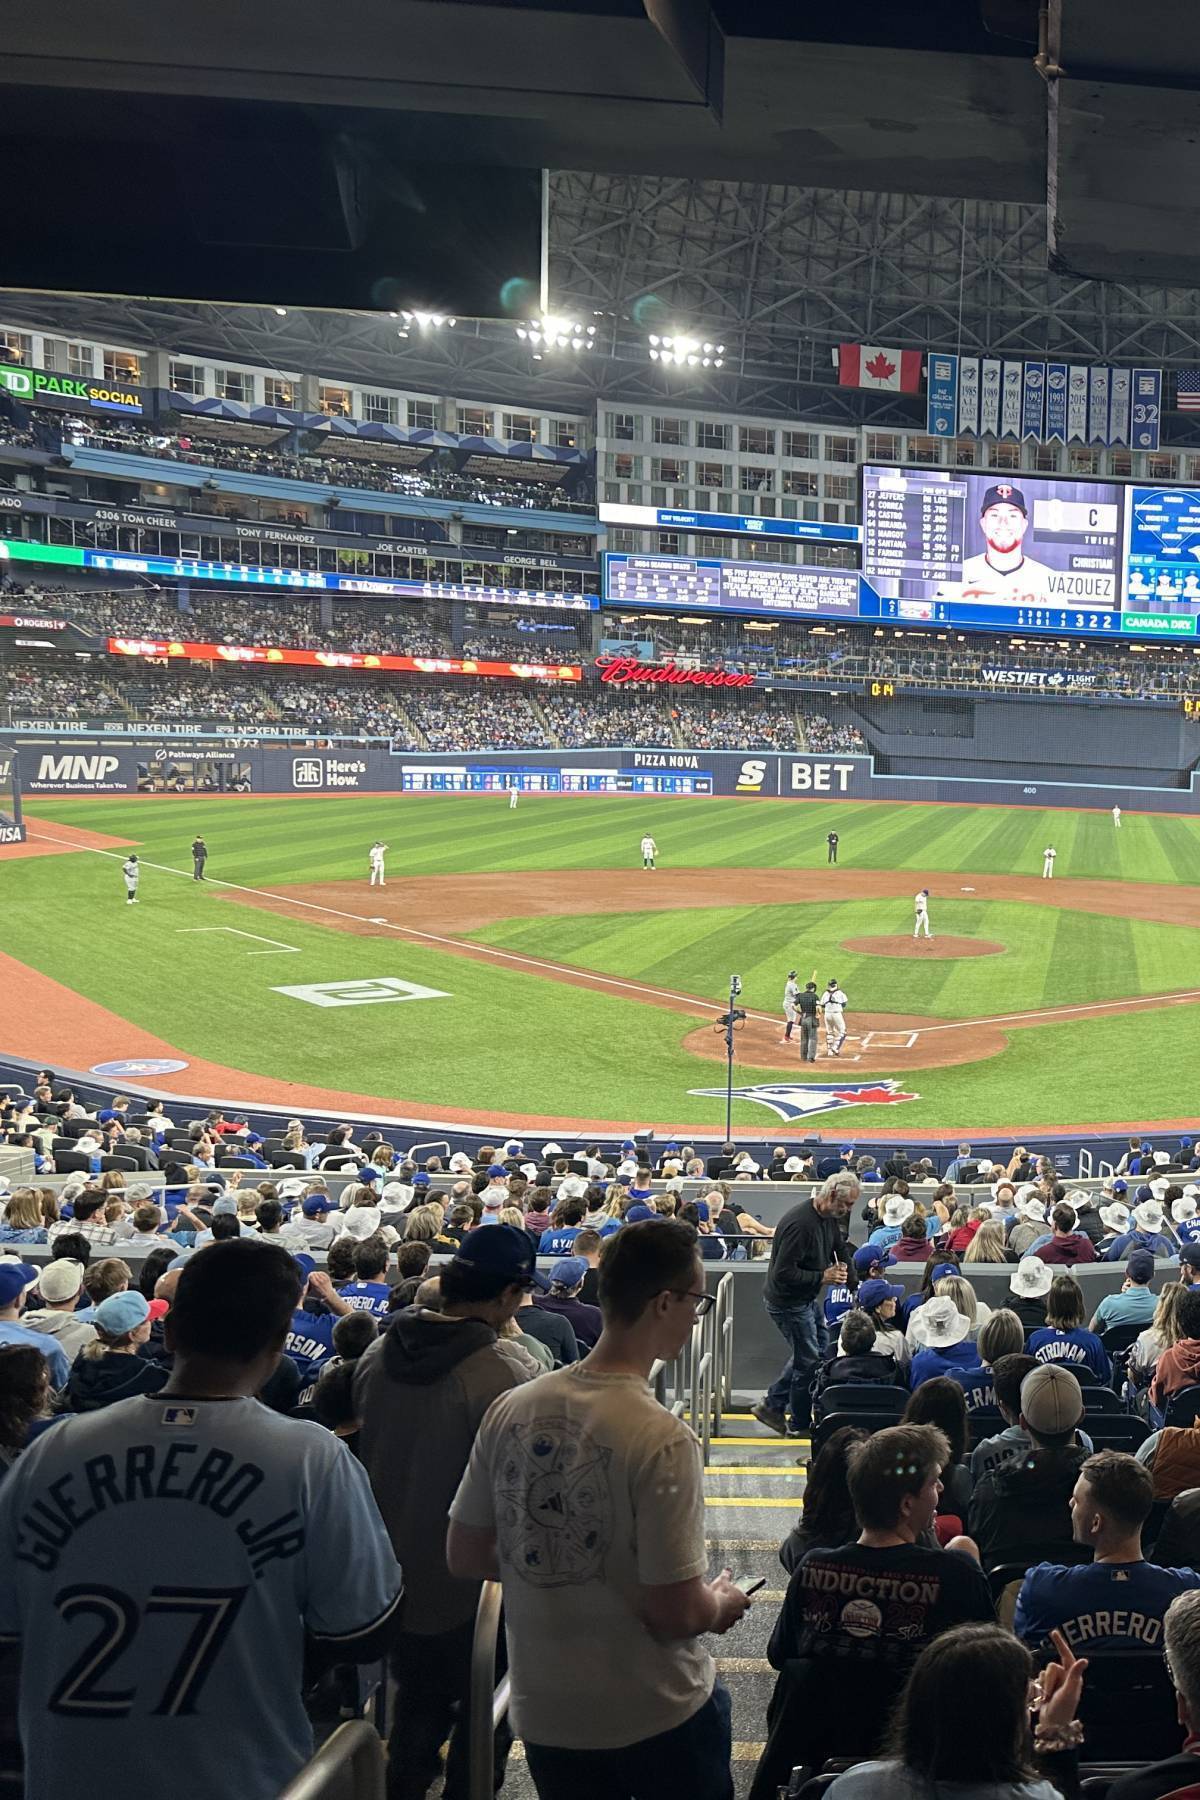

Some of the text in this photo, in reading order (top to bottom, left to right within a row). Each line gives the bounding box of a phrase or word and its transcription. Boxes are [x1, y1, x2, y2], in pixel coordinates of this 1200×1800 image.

[6, 371, 30, 391] TD
[35, 375, 88, 397] PARK
[90, 388, 142, 407] SOCIAL
[962, 386, 977, 396] 1985
[984, 388, 998, 398] 1989
[1004, 390, 1019, 400] 1991
[1026, 391, 1041, 402] 1992
[1049, 392, 1064, 404] 1993
[1070, 394, 1086, 405] 2015
[1091, 395, 1107, 406] 2016
[1134, 404, 1159, 424] 32
[878, 492, 906, 501] JEFFERS
[869, 500, 932, 513] 4 CORREA SS
[95, 510, 176, 528] 4306 TOM CHEEK
[878, 511, 902, 520] CASTRO
[922, 514, 932, 522] CF
[1088, 508, 1098, 527] C
[236, 527, 315, 544] TONY FERNANDEZ
[1084, 535, 1115, 545] TWINS
[376, 543, 428, 555] JOE CARTER
[878, 540, 907, 549] SANTANA
[503, 555, 558, 568] GEORGE BELL
[1072, 556, 1113, 570] CHRISTIAN
[877, 568, 930, 579] MARTIN LF
[1148, 568, 1156, 576] 9
[1048, 572, 1111, 596] VÁZQUEZ
[23, 620, 54, 629] ROGERS
[1076, 614, 1112, 628] 3 2 2
[1126, 617, 1191, 630] CANADA DRY
[595, 654, 756, 688] Budweiser
[982, 669, 1096, 686] WESTJET FLIGHT
[60, 722, 88, 732] TIRE
[127, 723, 172, 734] NEXEN
[174, 724, 202, 735] TIRE
[281, 727, 309, 736] TIRE
[168, 751, 235, 760] Pathways Alliance
[634, 753, 698, 769] PIZZA NOVA
[38, 755, 119, 780] MNP
[326, 760, 366, 774] Here's
[326, 773, 359, 786] How.
[791, 762, 854, 791] BET
[30, 782, 127, 790] Wherever Business Takes You
[552, 1238, 573, 1249] RYU
[374, 1300, 390, 1314] JR.
[1035, 1341, 1086, 1364] STROMAN
[15, 1443, 305, 1580] GUERRERO JR.
[800, 1566, 941, 1603] INDUCTION
[48, 1582, 249, 1718] 27
